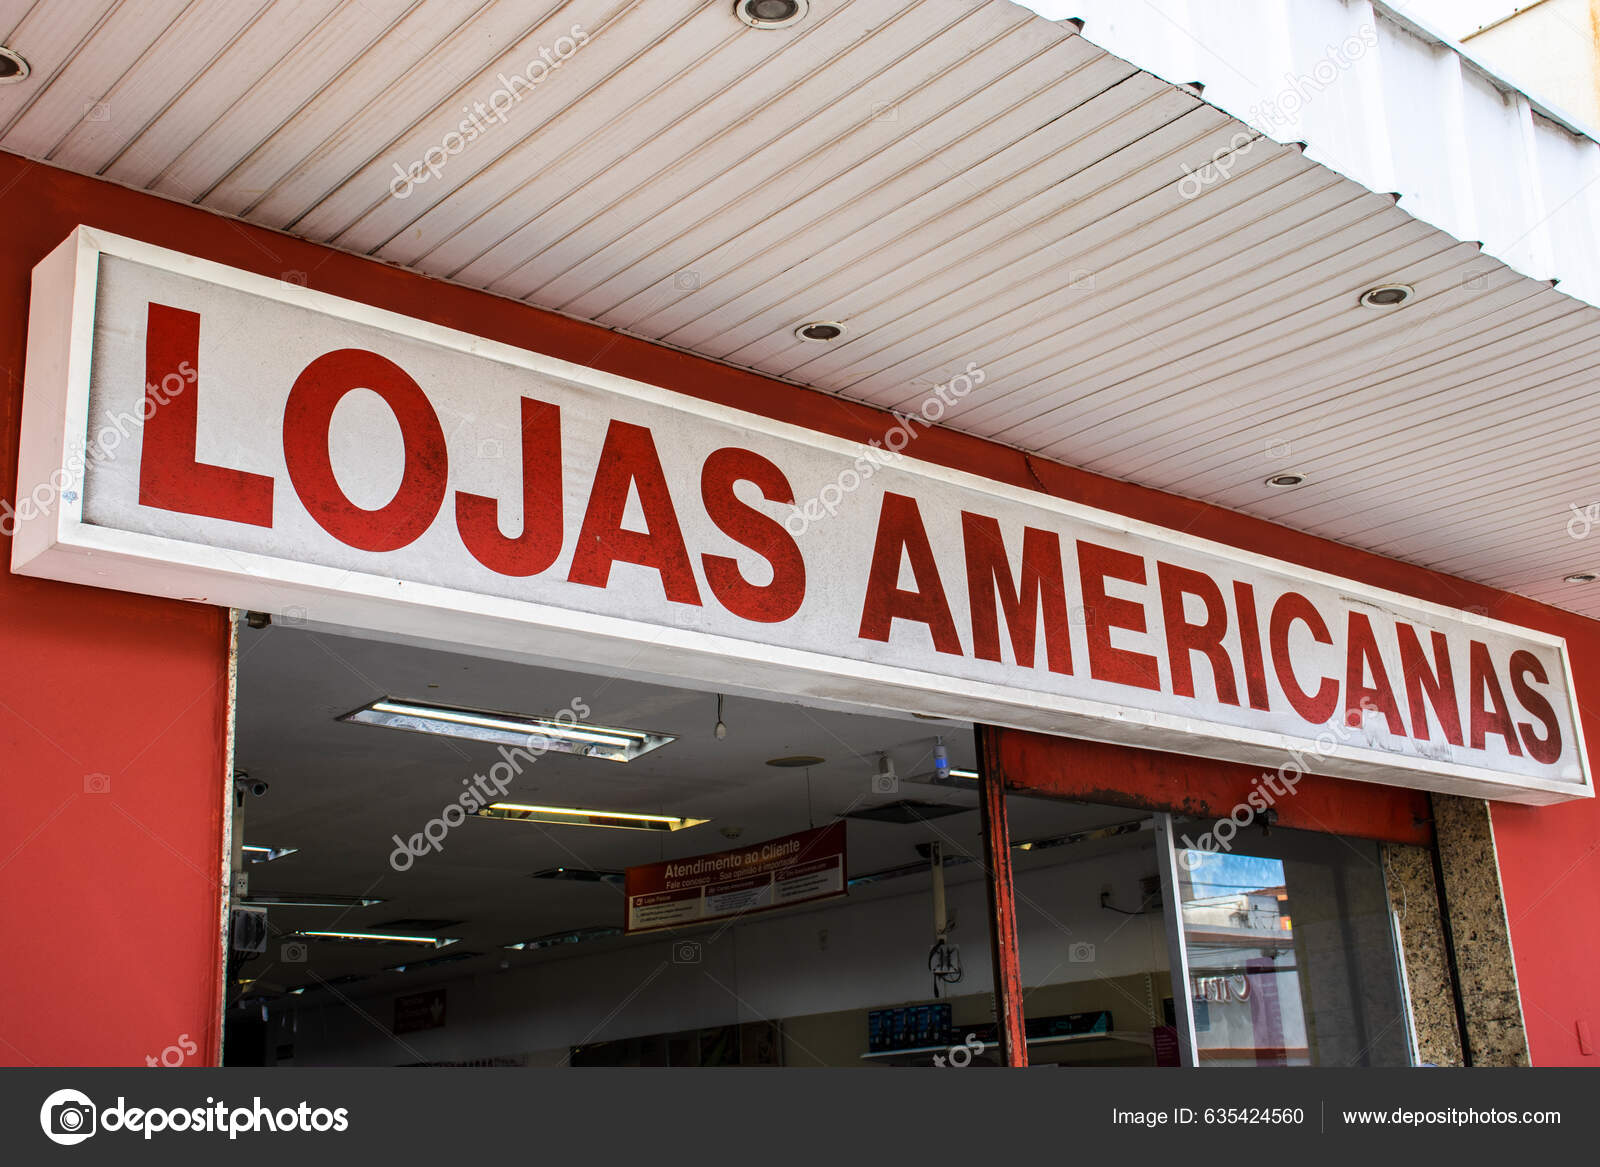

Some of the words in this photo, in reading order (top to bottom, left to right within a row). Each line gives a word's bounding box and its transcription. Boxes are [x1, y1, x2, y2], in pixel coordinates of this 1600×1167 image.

[138, 302, 807, 624] LOJAS
[858, 490, 1561, 764] AMERICANAS
[664, 855, 742, 880] Atendimento
[744, 852, 759, 864] ao
[761, 839, 800, 860] Cliente
[666, 879, 681, 889] Fale
